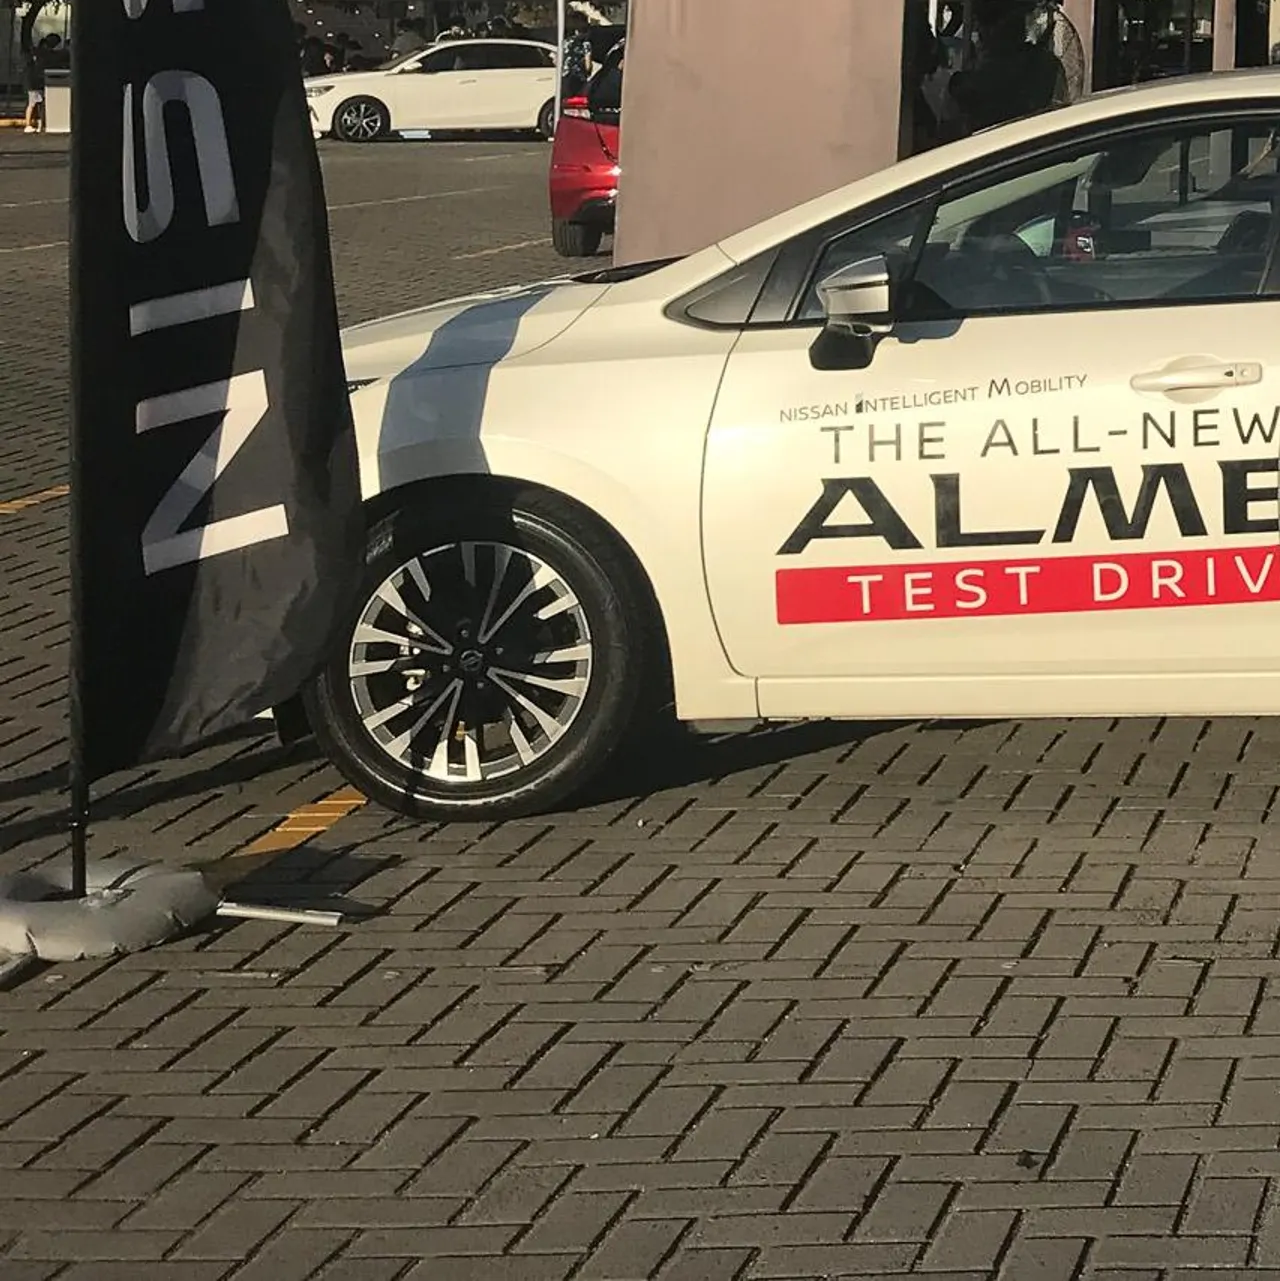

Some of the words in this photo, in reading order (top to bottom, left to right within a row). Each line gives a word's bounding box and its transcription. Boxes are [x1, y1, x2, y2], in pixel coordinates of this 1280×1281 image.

[779, 402, 848, 422] NISSAN
[855, 385, 979, 414] INTELLIGENT
[987, 373, 1088, 399] MOBILITY
[821, 417, 946, 465] THE
[847, 564, 1042, 615] TEST
